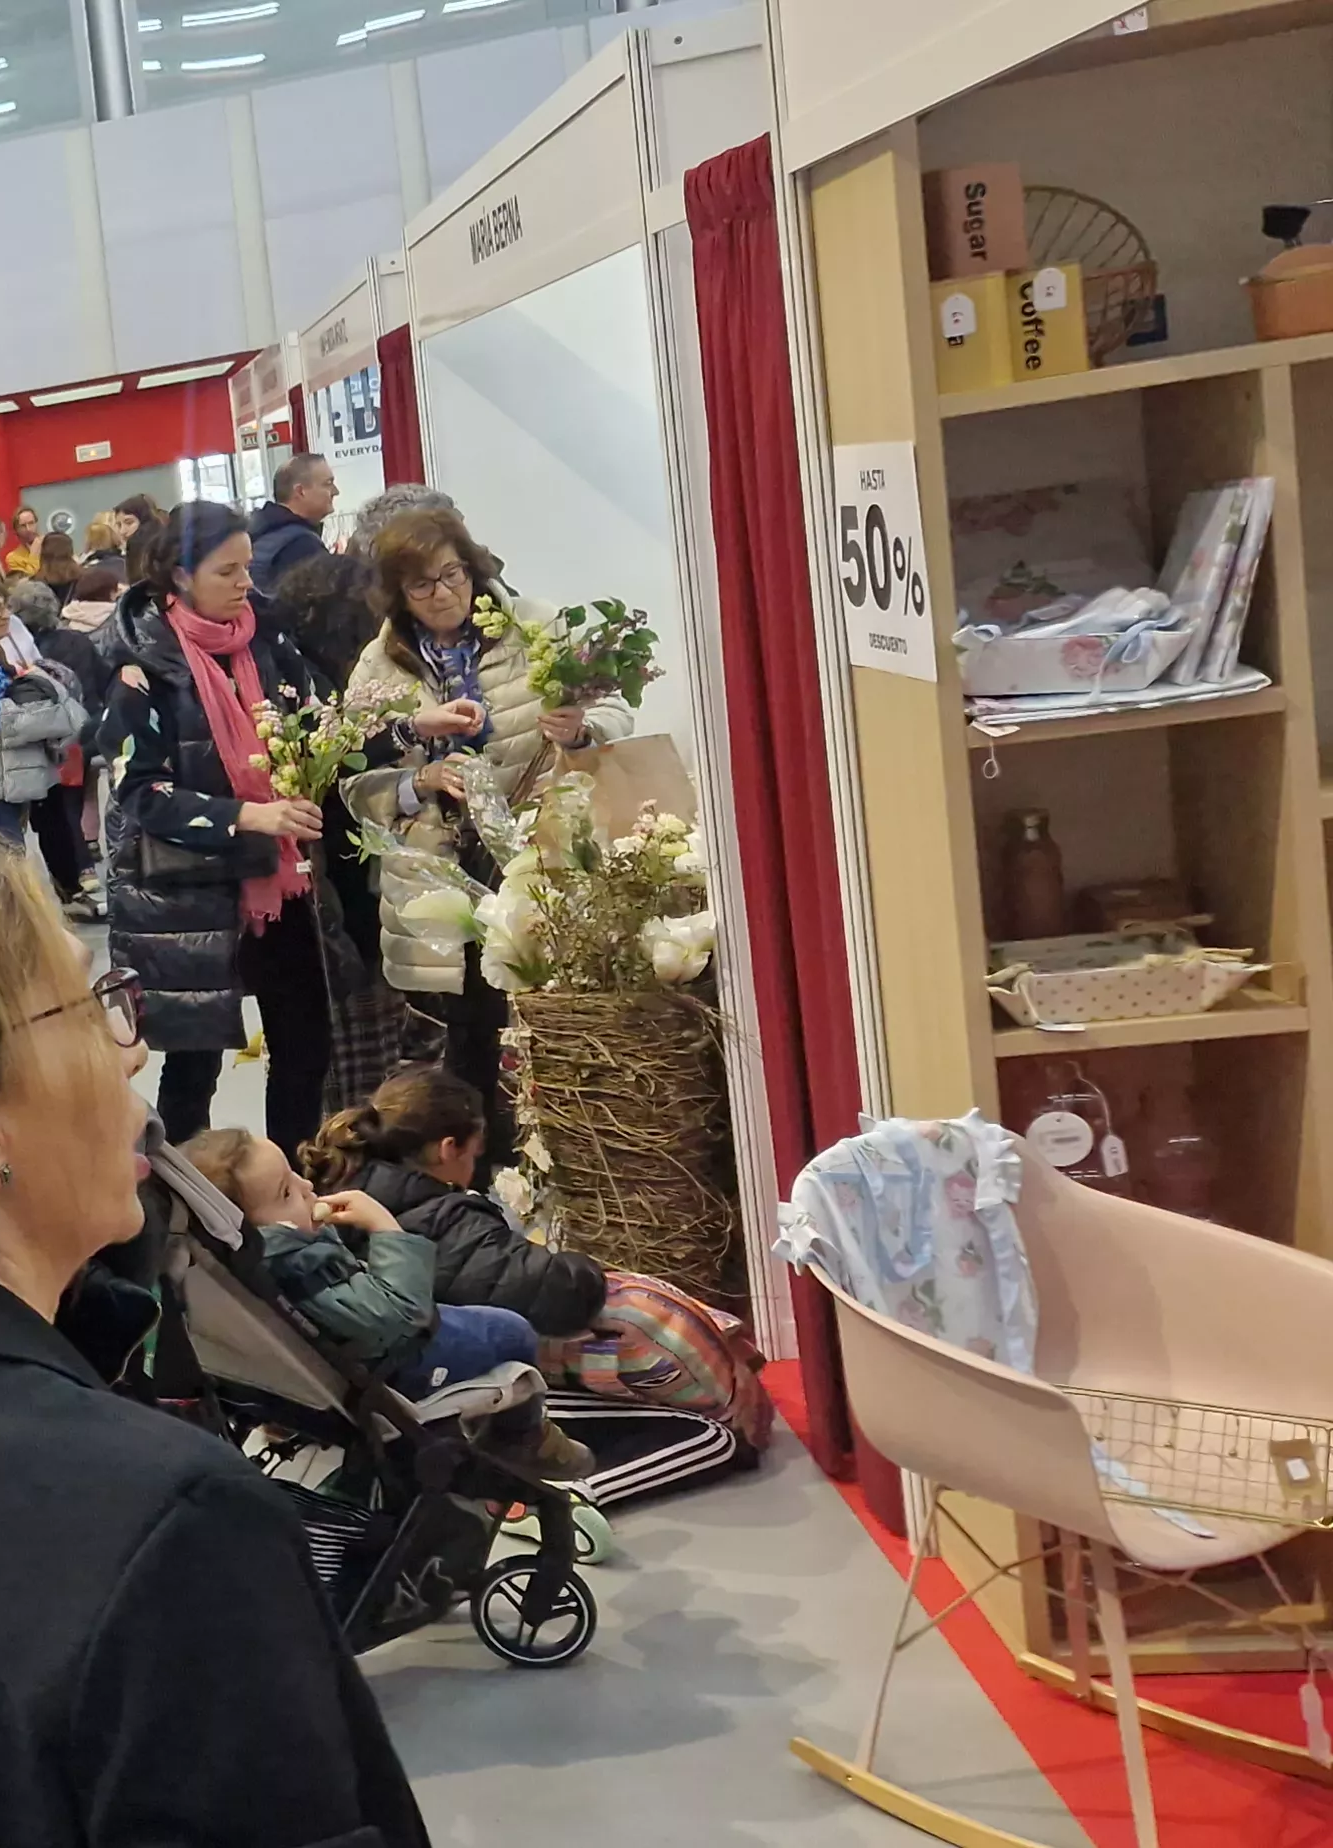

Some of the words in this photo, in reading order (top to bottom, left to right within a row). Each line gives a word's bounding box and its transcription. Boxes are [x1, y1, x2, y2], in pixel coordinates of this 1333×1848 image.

[492, 193, 523, 253] BERNA
[963, 182, 988, 262] Sugar
[860, 469, 886, 492] HASTA
[840, 503, 925, 617] 50%
